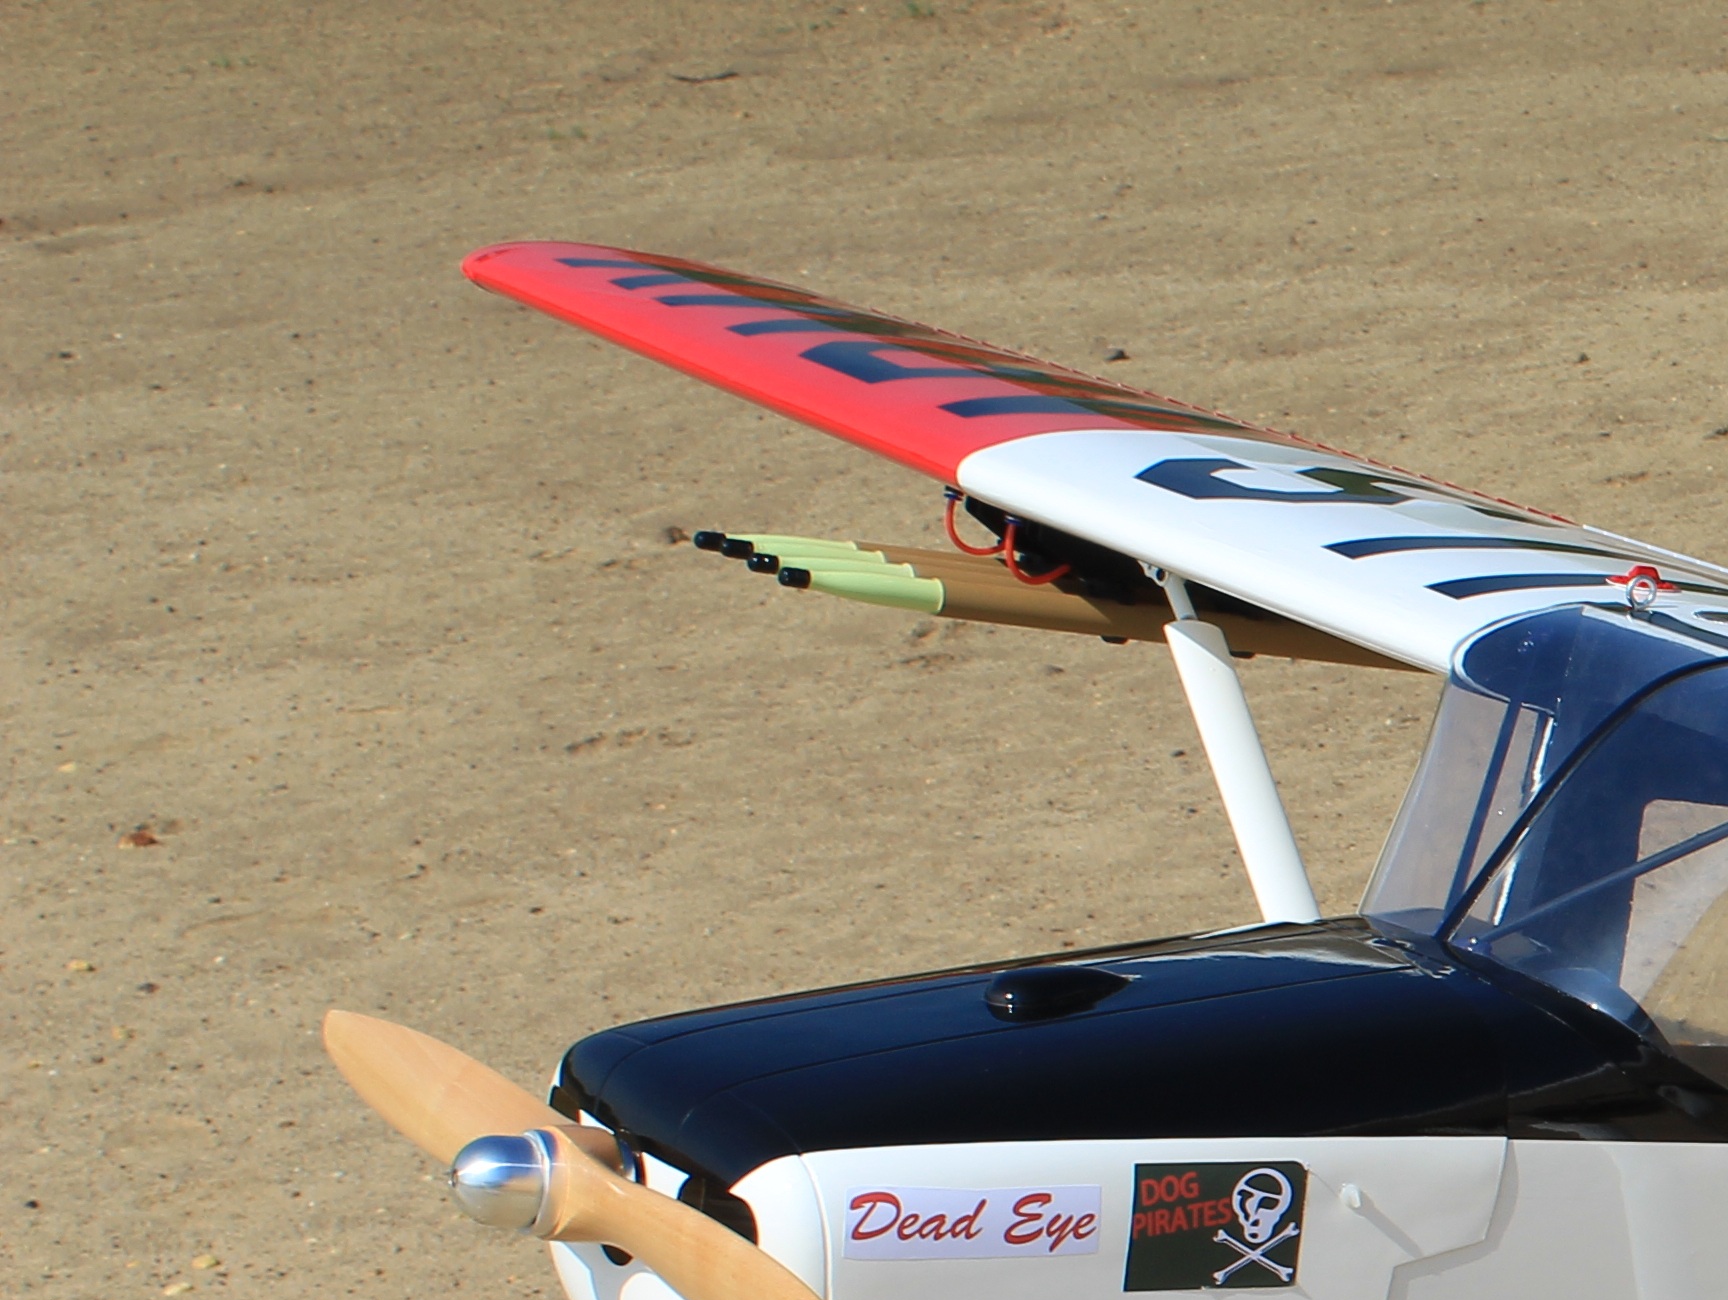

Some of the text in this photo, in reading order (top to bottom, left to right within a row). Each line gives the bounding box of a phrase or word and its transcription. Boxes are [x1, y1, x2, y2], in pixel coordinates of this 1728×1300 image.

[1140, 1171, 1200, 1207] DOG
[849, 1191, 1098, 1253] Dead Eye
[1132, 1197, 1233, 1240] PIRATES
